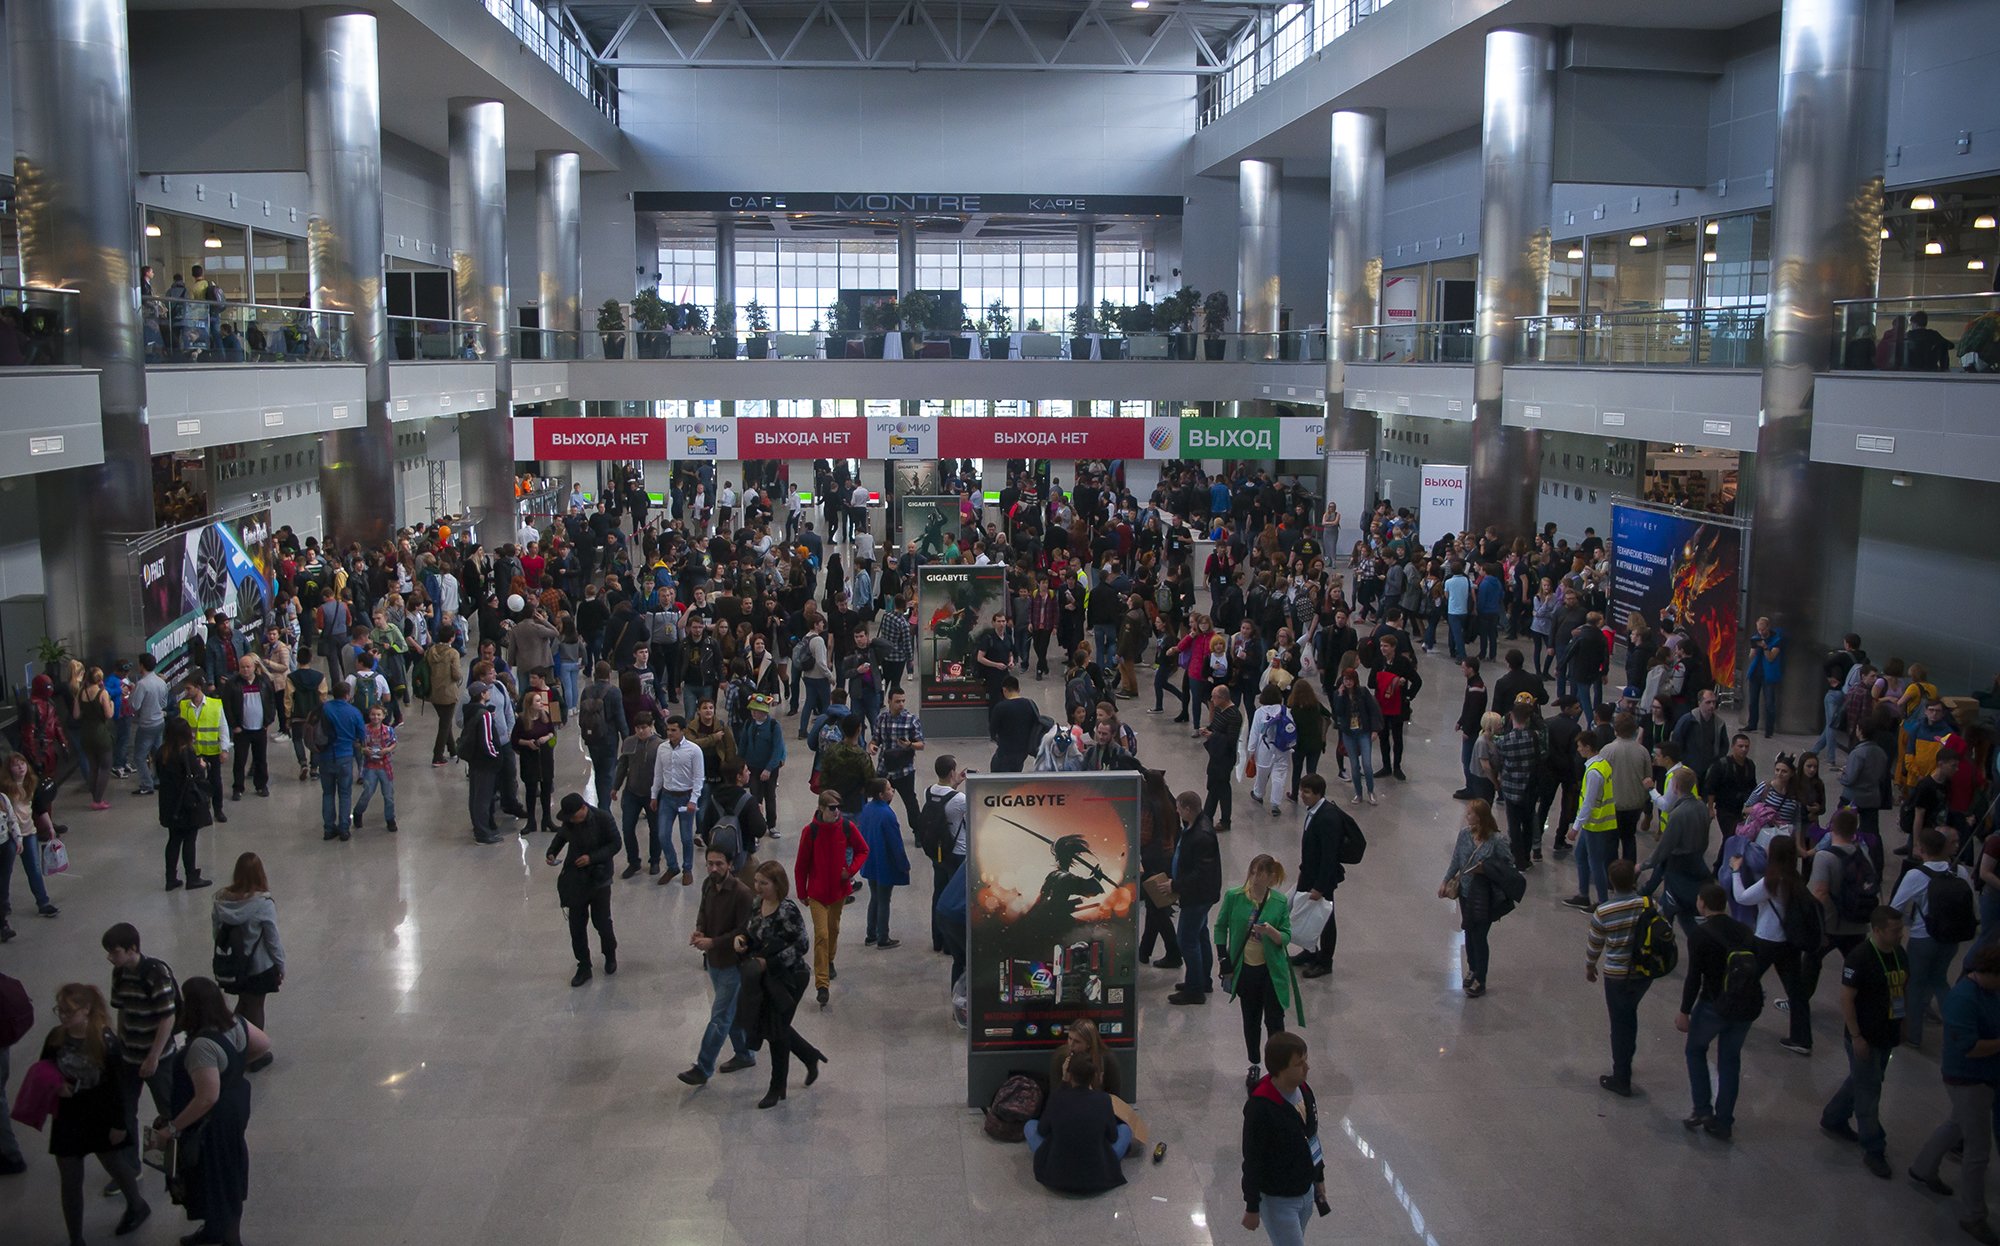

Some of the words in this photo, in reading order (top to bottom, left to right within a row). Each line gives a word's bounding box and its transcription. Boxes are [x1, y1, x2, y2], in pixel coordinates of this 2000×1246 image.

[730, 196, 786, 208] CAFE
[834, 195, 981, 211] MONTRE
[1028, 198, 1086, 210] КАФЕ
[552, 433, 616, 446] ВЫХОДА
[620, 433, 649, 445] НЕТ
[755, 432, 820, 446] ВЫХОДА
[824, 432, 851, 444] НЕТ
[994, 432, 1057, 446] ВЫХОДА
[1061, 432, 1089, 444] НЕТ
[1189, 430, 1272, 450] ВЫХОД
[1424, 478, 1462, 488] ВЫХОД
[1432, 498, 1454, 507] EXIT
[926, 574, 968, 582] GIGABYTE
[984, 794, 1066, 808] GIGABYTE
